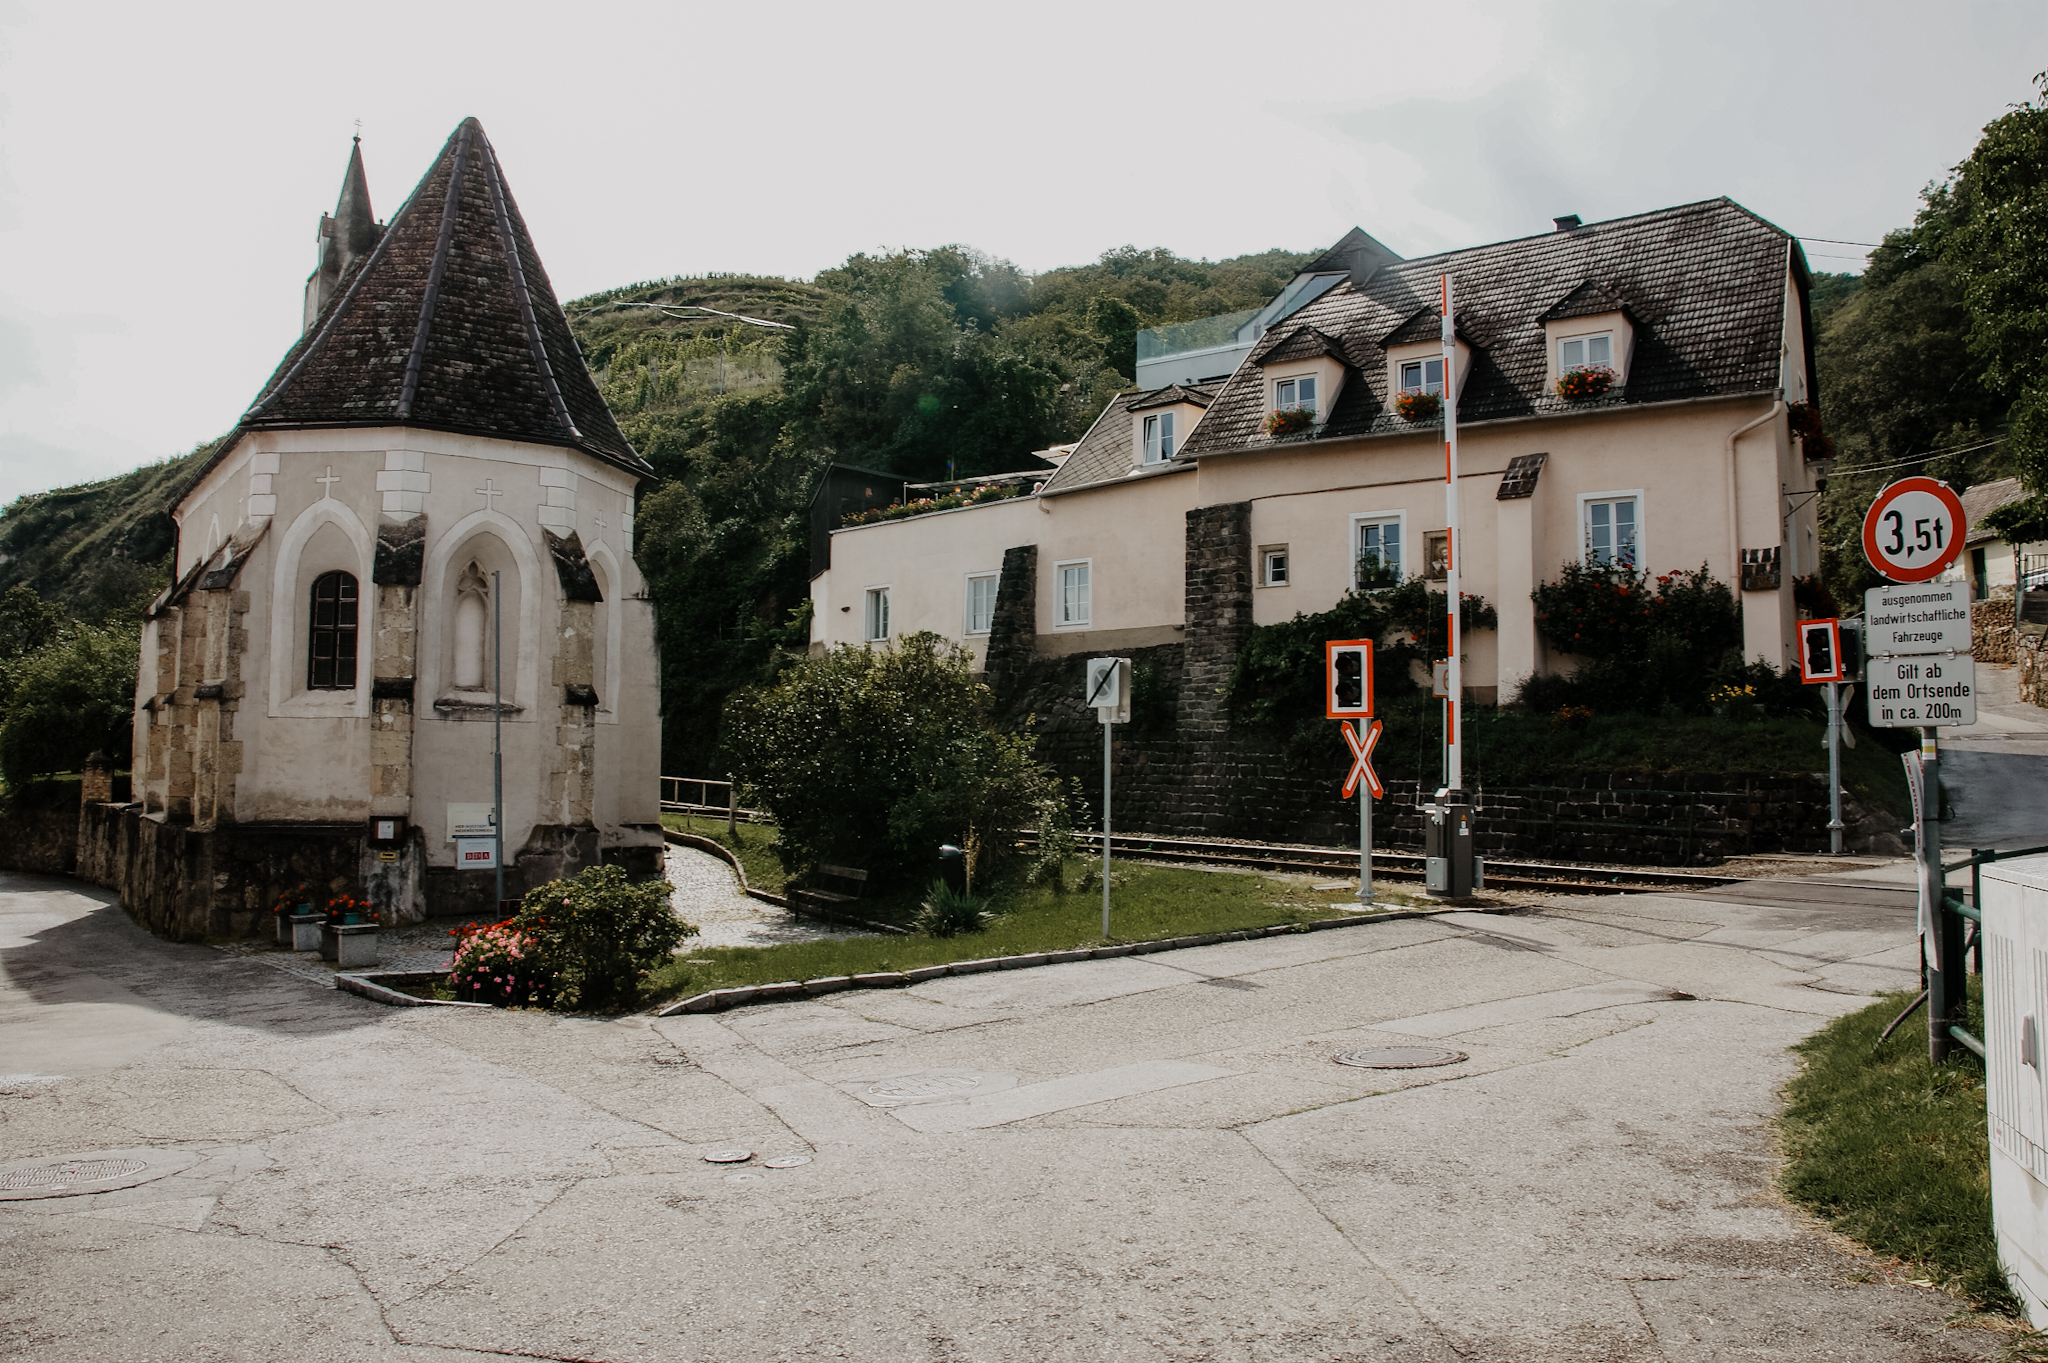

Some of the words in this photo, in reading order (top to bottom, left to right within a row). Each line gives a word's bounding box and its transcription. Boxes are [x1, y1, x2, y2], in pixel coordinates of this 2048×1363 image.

[1883, 510, 1944, 559] 3,5t
[1881, 590, 1953, 608] ausgenommen
[1870, 609, 1966, 626] landwirtschaftliche
[1892, 630, 1943, 644] Fahrzeuge
[1897, 664, 1919, 680] Gilt
[1925, 663, 1942, 679] ab
[1873, 685, 1900, 701] dem
[1907, 682, 1970, 700] Ortsende
[1881, 704, 1893, 720] in
[1900, 706, 1920, 720] ca.
[1925, 703, 1962, 719] 200m
